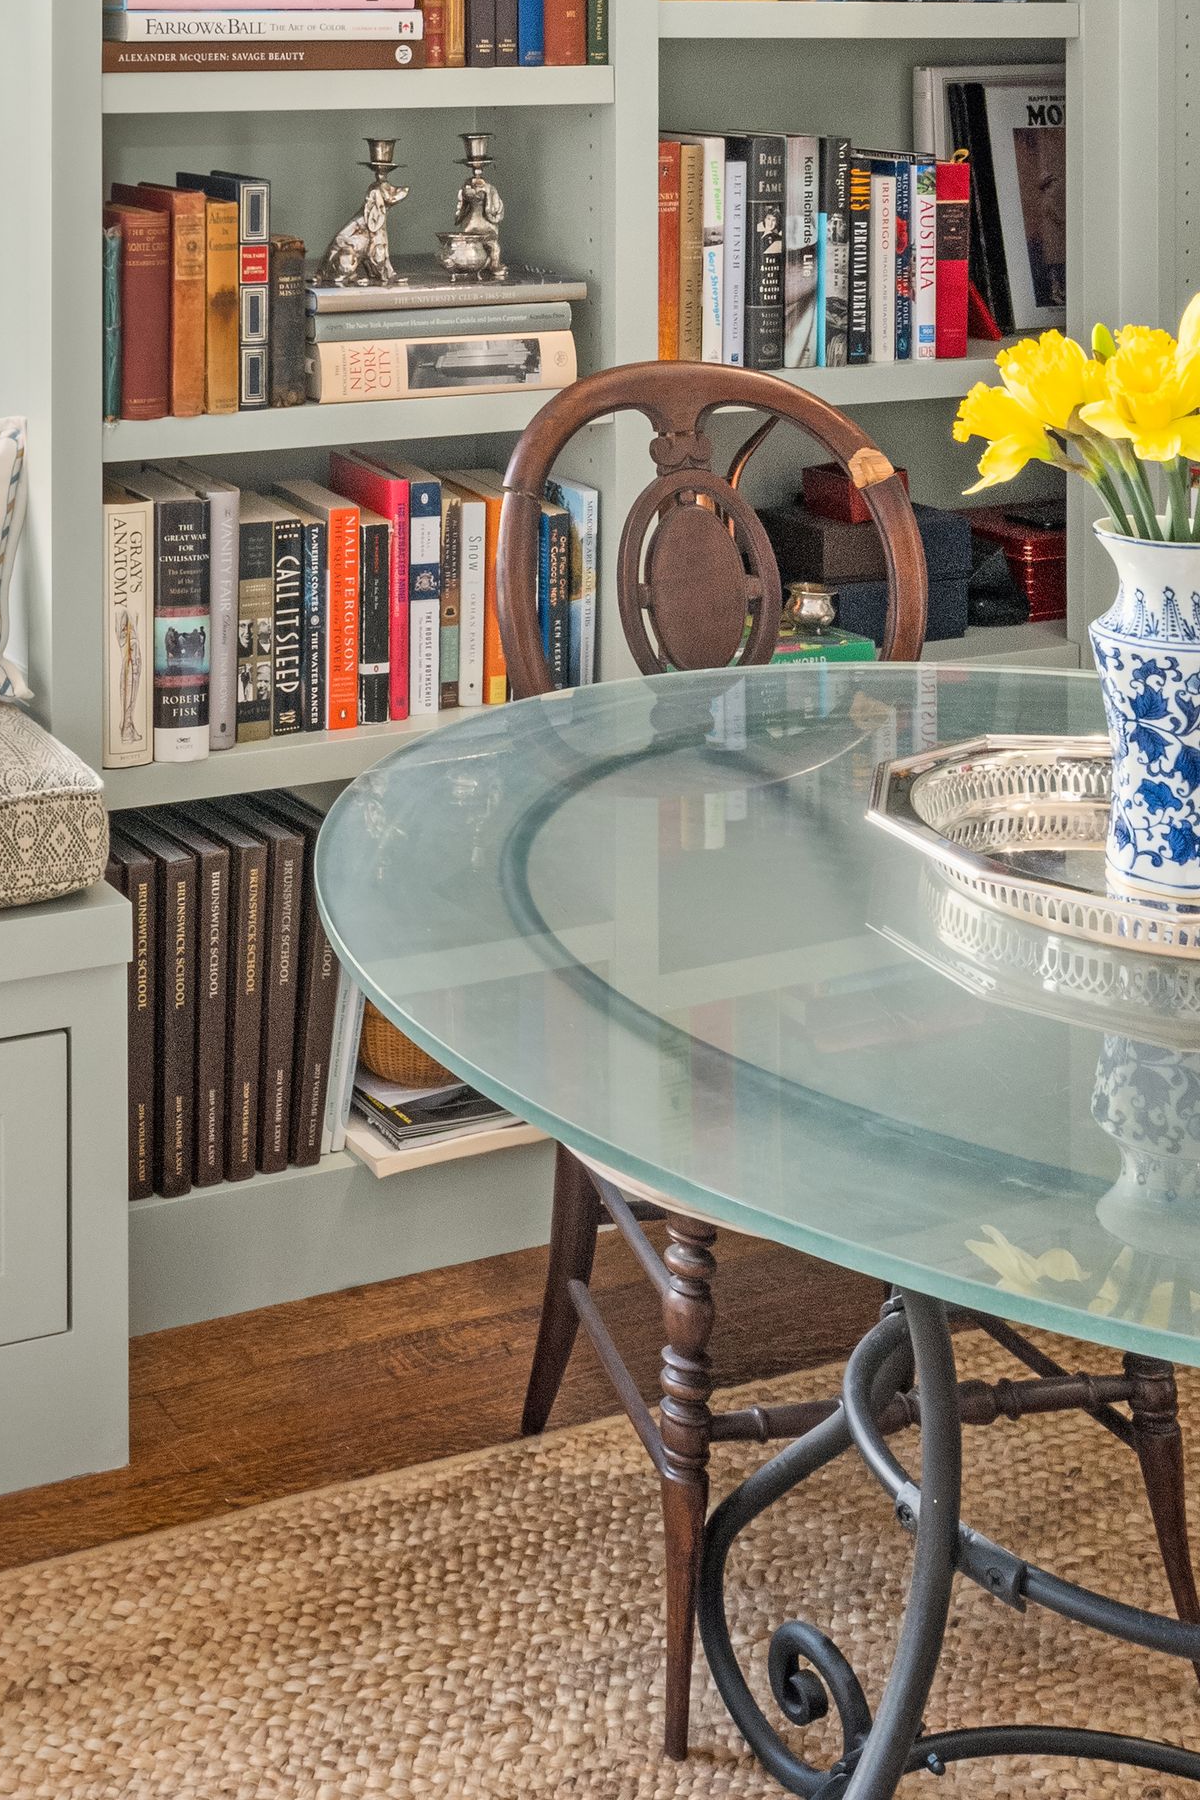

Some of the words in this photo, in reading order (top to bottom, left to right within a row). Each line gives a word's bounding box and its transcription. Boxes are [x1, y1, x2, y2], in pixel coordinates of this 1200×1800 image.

[270, 24, 285, 32] THE
[288, 24, 304, 32] ART
[319, 23, 346, 32] COLOR
[118, 53, 177, 62] ALEXANDER
[231, 52, 266, 61] SAVAGE
[268, 52, 305, 61] BEAUTY
[1027, 105, 1066, 126] MO
[759, 153, 782, 165] RAGE
[804, 156, 814, 186] Keith
[838, 143, 848, 158] No
[687, 156, 695, 223] FERGUSON
[711, 160, 720, 186] Little
[758, 181, 782, 193] FAME
[835, 163, 848, 208] Regrets
[850, 168, 871, 210] JAMES
[713, 188, 722, 221] Failure
[733, 204, 741, 219] ME
[804, 191, 814, 244] Richards
[707, 252, 717, 274] Gary
[733, 226, 741, 270] FINISH
[803, 254, 813, 276] Life
[853, 221, 867, 277] PERCIVAL
[920, 200, 934, 290] AUSTRIA
[686, 279, 693, 295] OF
[711, 275, 722, 326] Shteyngart
[853, 281, 867, 332] EVERETT
[685, 301, 693, 344] MONEY
[349, 348, 362, 390] NEW
[364, 344, 375, 393] YORK
[377, 347, 392, 388] CITY
[334, 518, 342, 536] THE
[345, 516, 356, 569] NIALL
[113, 518, 128, 608] ANATOMY
[130, 531, 142, 594] GRAY'S
[159, 553, 210, 562] CIVILISATION
[333, 546, 342, 595] SQUARE
[469, 536, 482, 571] Snow
[276, 556, 301, 603] CALL
[585, 595, 592, 606] OF
[276, 608, 300, 627] IT
[344, 576, 355, 672] FERGUSON
[275, 632, 300, 693] SLEEP
[333, 629, 341, 672] TOWER
[425, 653, 432, 661] OF
[162, 692, 208, 705] ROBERT
[173, 707, 197, 717] FISK
[210, 871, 220, 946] BRUNSWICK
[248, 868, 259, 942] BRUNSWICK
[281, 860, 293, 932] BRUNSWICK
[138, 883, 147, 957] BRUNSWICK
[176, 881, 186, 955] BRUNSWICK
[210, 948, 219, 999] SCHOOL
[246, 944, 257, 995] SCHOOL
[280, 935, 290, 985] SCHOOL
[138, 959, 147, 1011] SCHOOL
[175, 958, 185, 1009] SCHOOL
